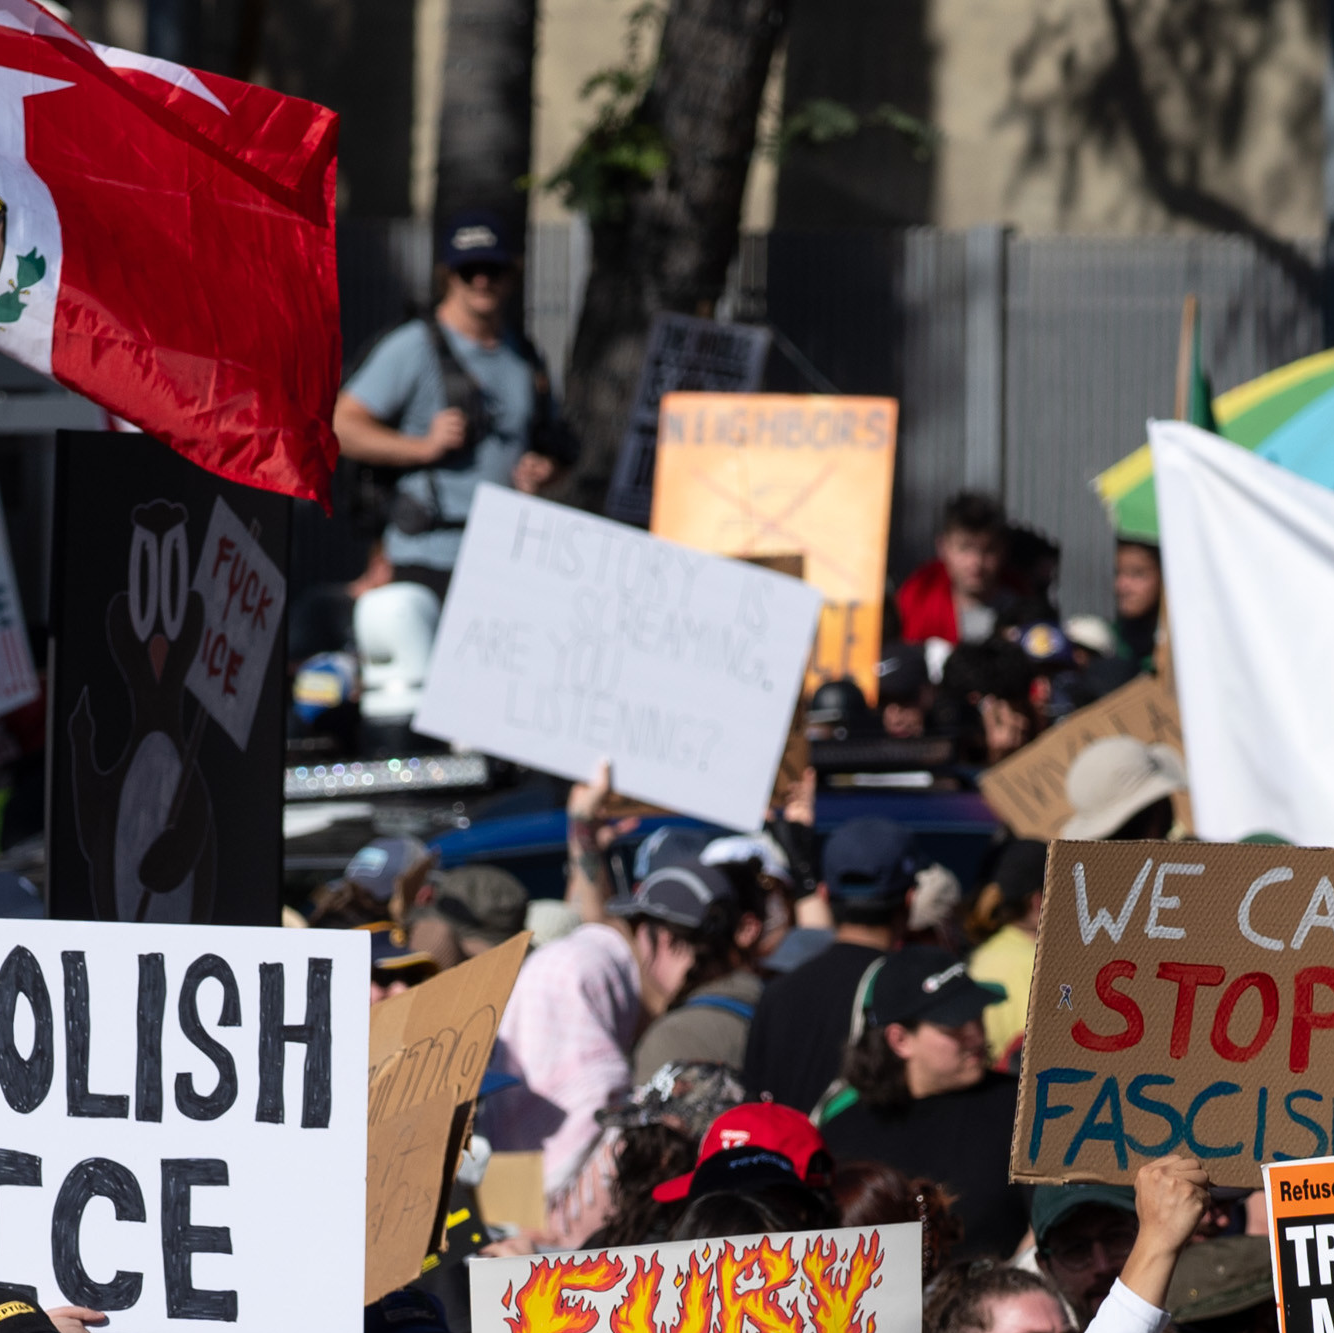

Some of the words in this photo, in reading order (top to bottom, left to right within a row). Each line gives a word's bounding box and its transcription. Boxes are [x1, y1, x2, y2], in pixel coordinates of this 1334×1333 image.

[211, 536, 274, 631] FUCK
[510, 507, 705, 607] HISTORY
[735, 573, 773, 635] IS
[201, 628, 243, 698] ICE
[453, 616, 534, 676] ARE
[548, 625, 624, 697] YOU
[572, 585, 774, 692] SCREAMING.
[505, 678, 724, 772] LISTENING?
[1072, 857, 1206, 945] WE
